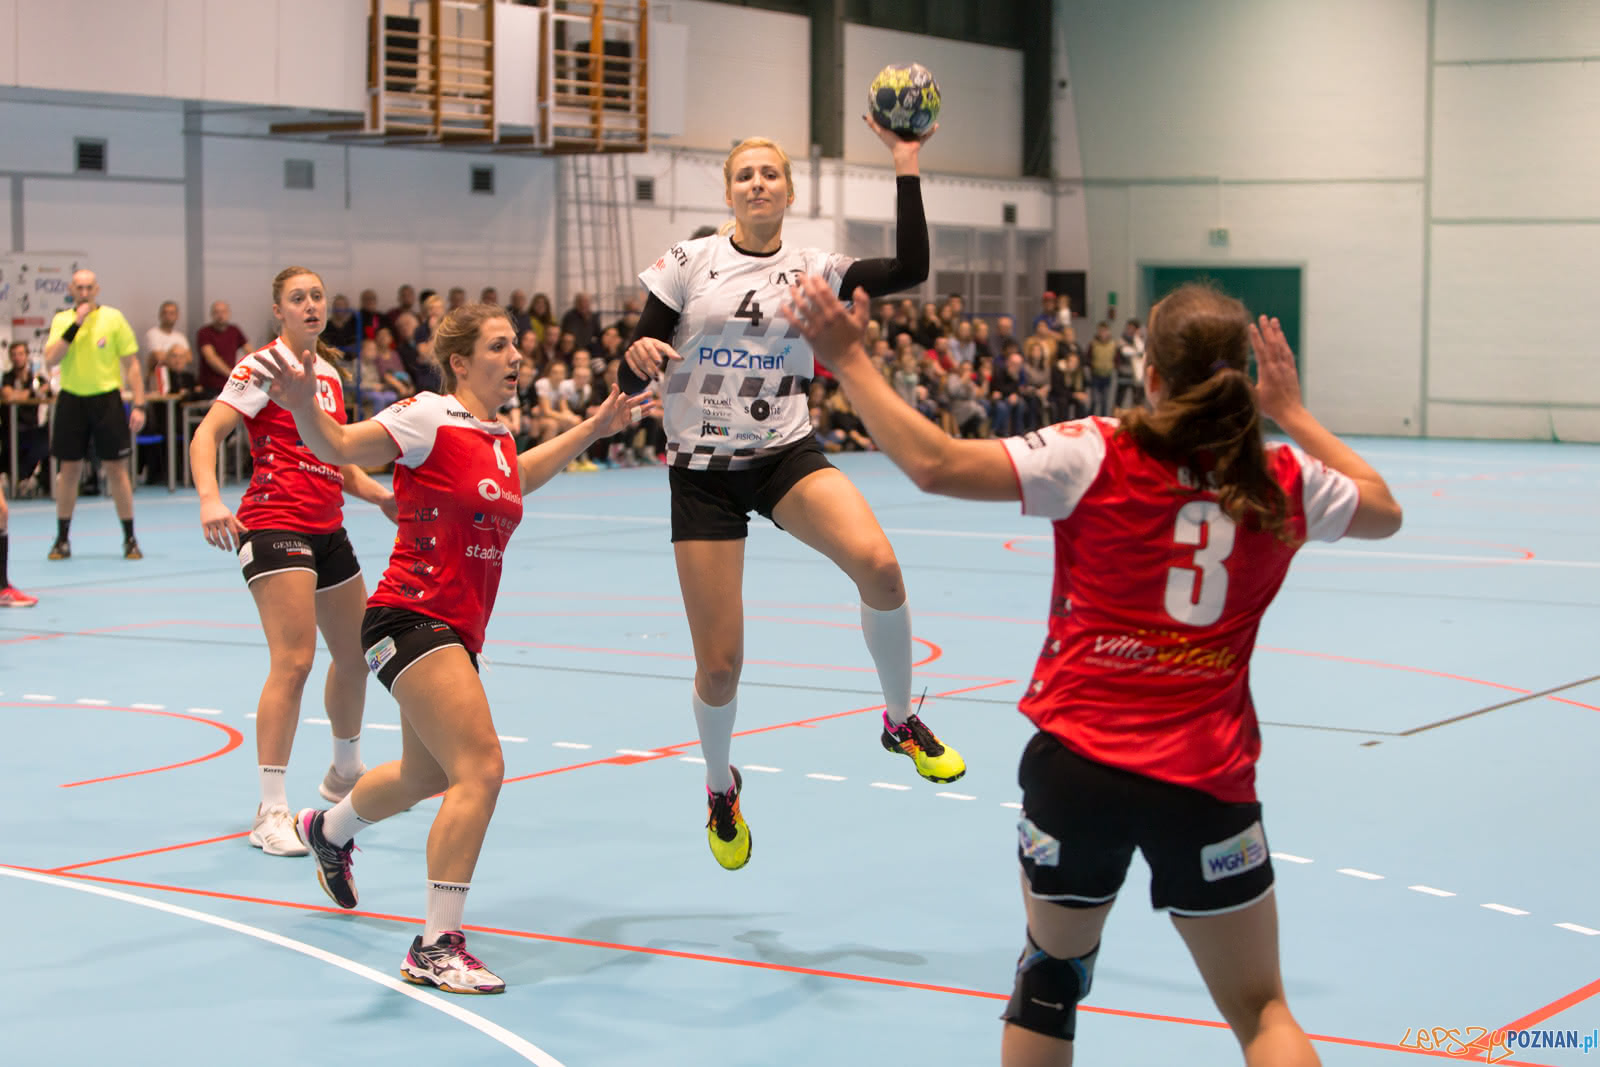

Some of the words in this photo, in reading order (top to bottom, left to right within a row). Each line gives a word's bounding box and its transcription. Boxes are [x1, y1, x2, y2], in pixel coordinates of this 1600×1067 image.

[734, 290, 763, 326] 4
[493, 439, 511, 478] 4
[1164, 501, 1237, 627] 3
